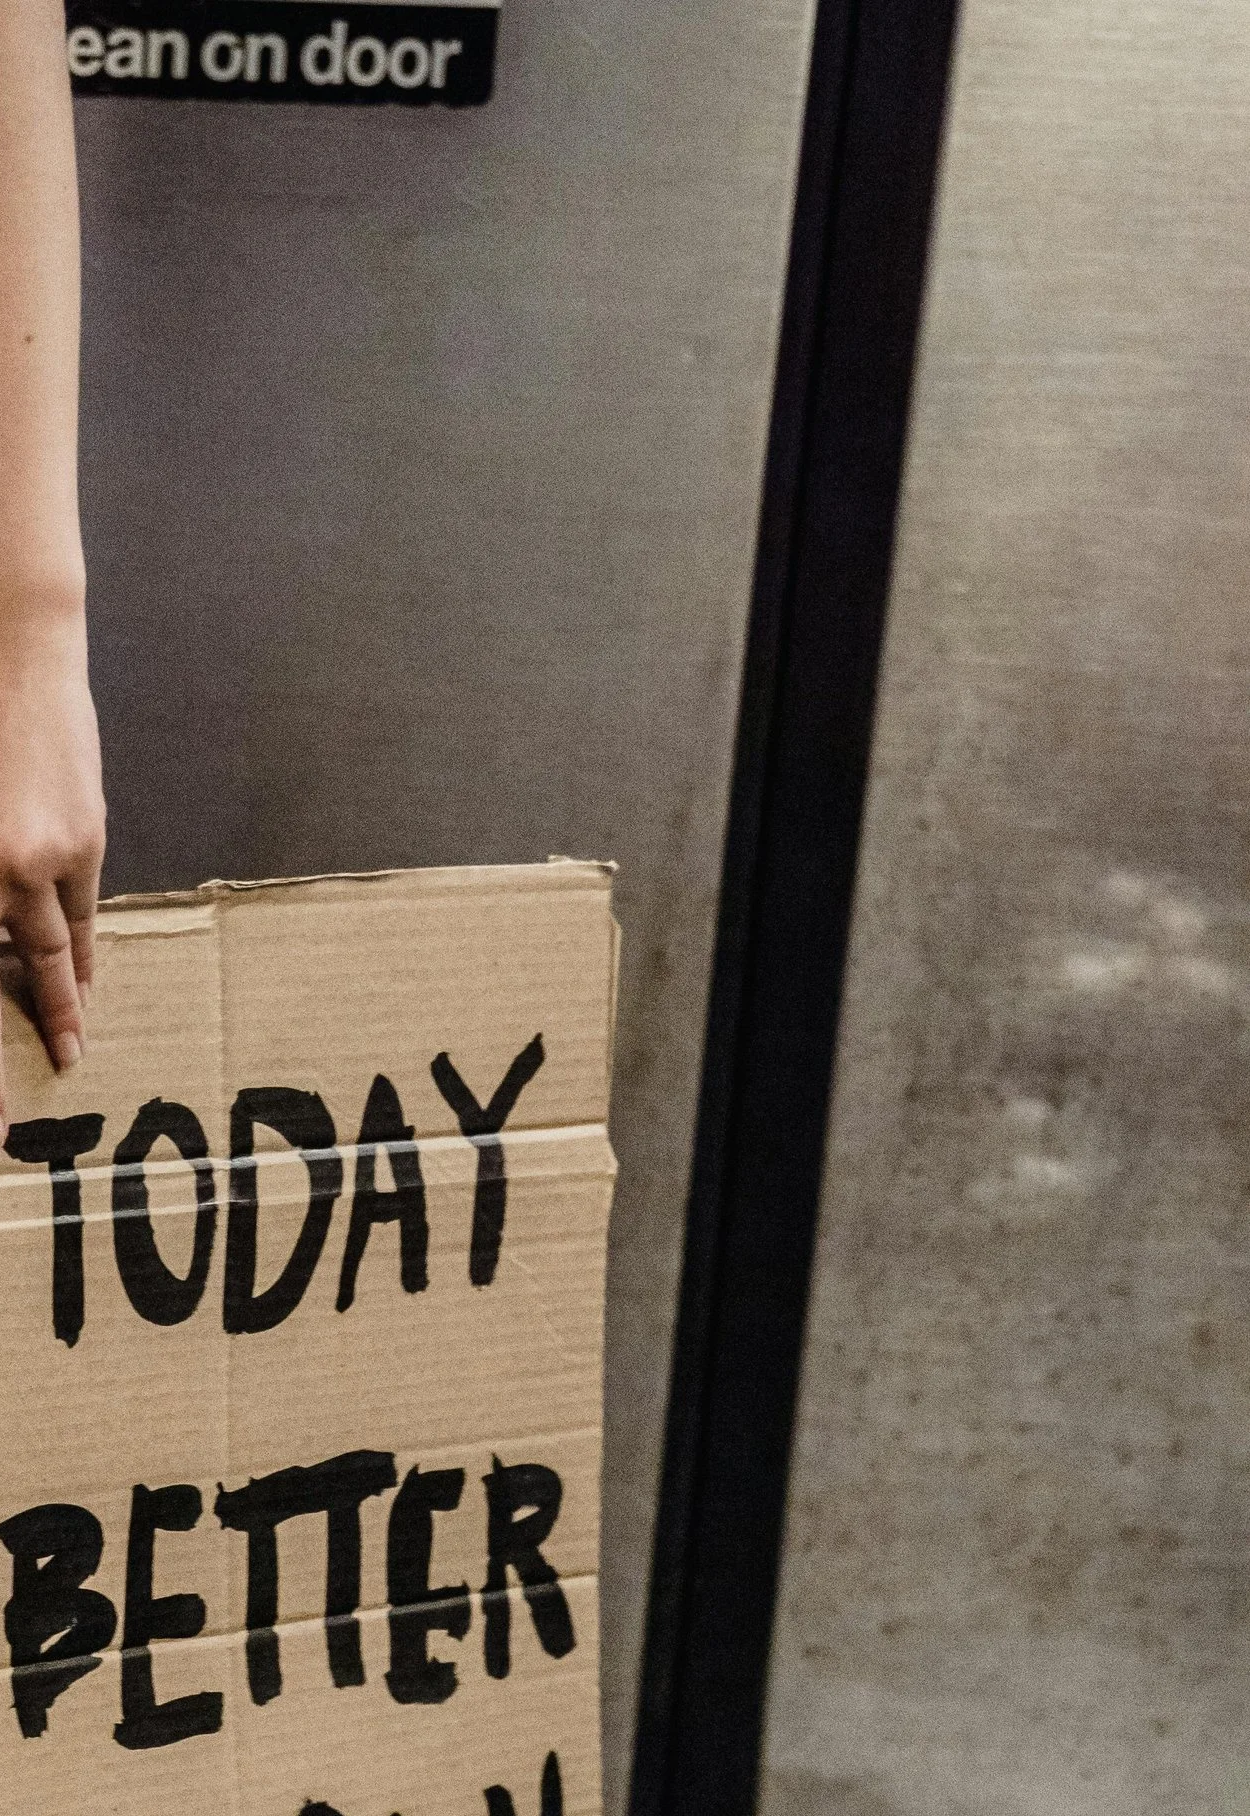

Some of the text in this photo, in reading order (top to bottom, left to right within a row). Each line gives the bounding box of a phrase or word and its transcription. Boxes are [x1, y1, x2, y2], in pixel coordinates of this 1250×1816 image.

[67, 18, 463, 90] ean on door
[1, 1031, 546, 1350] TODAY
